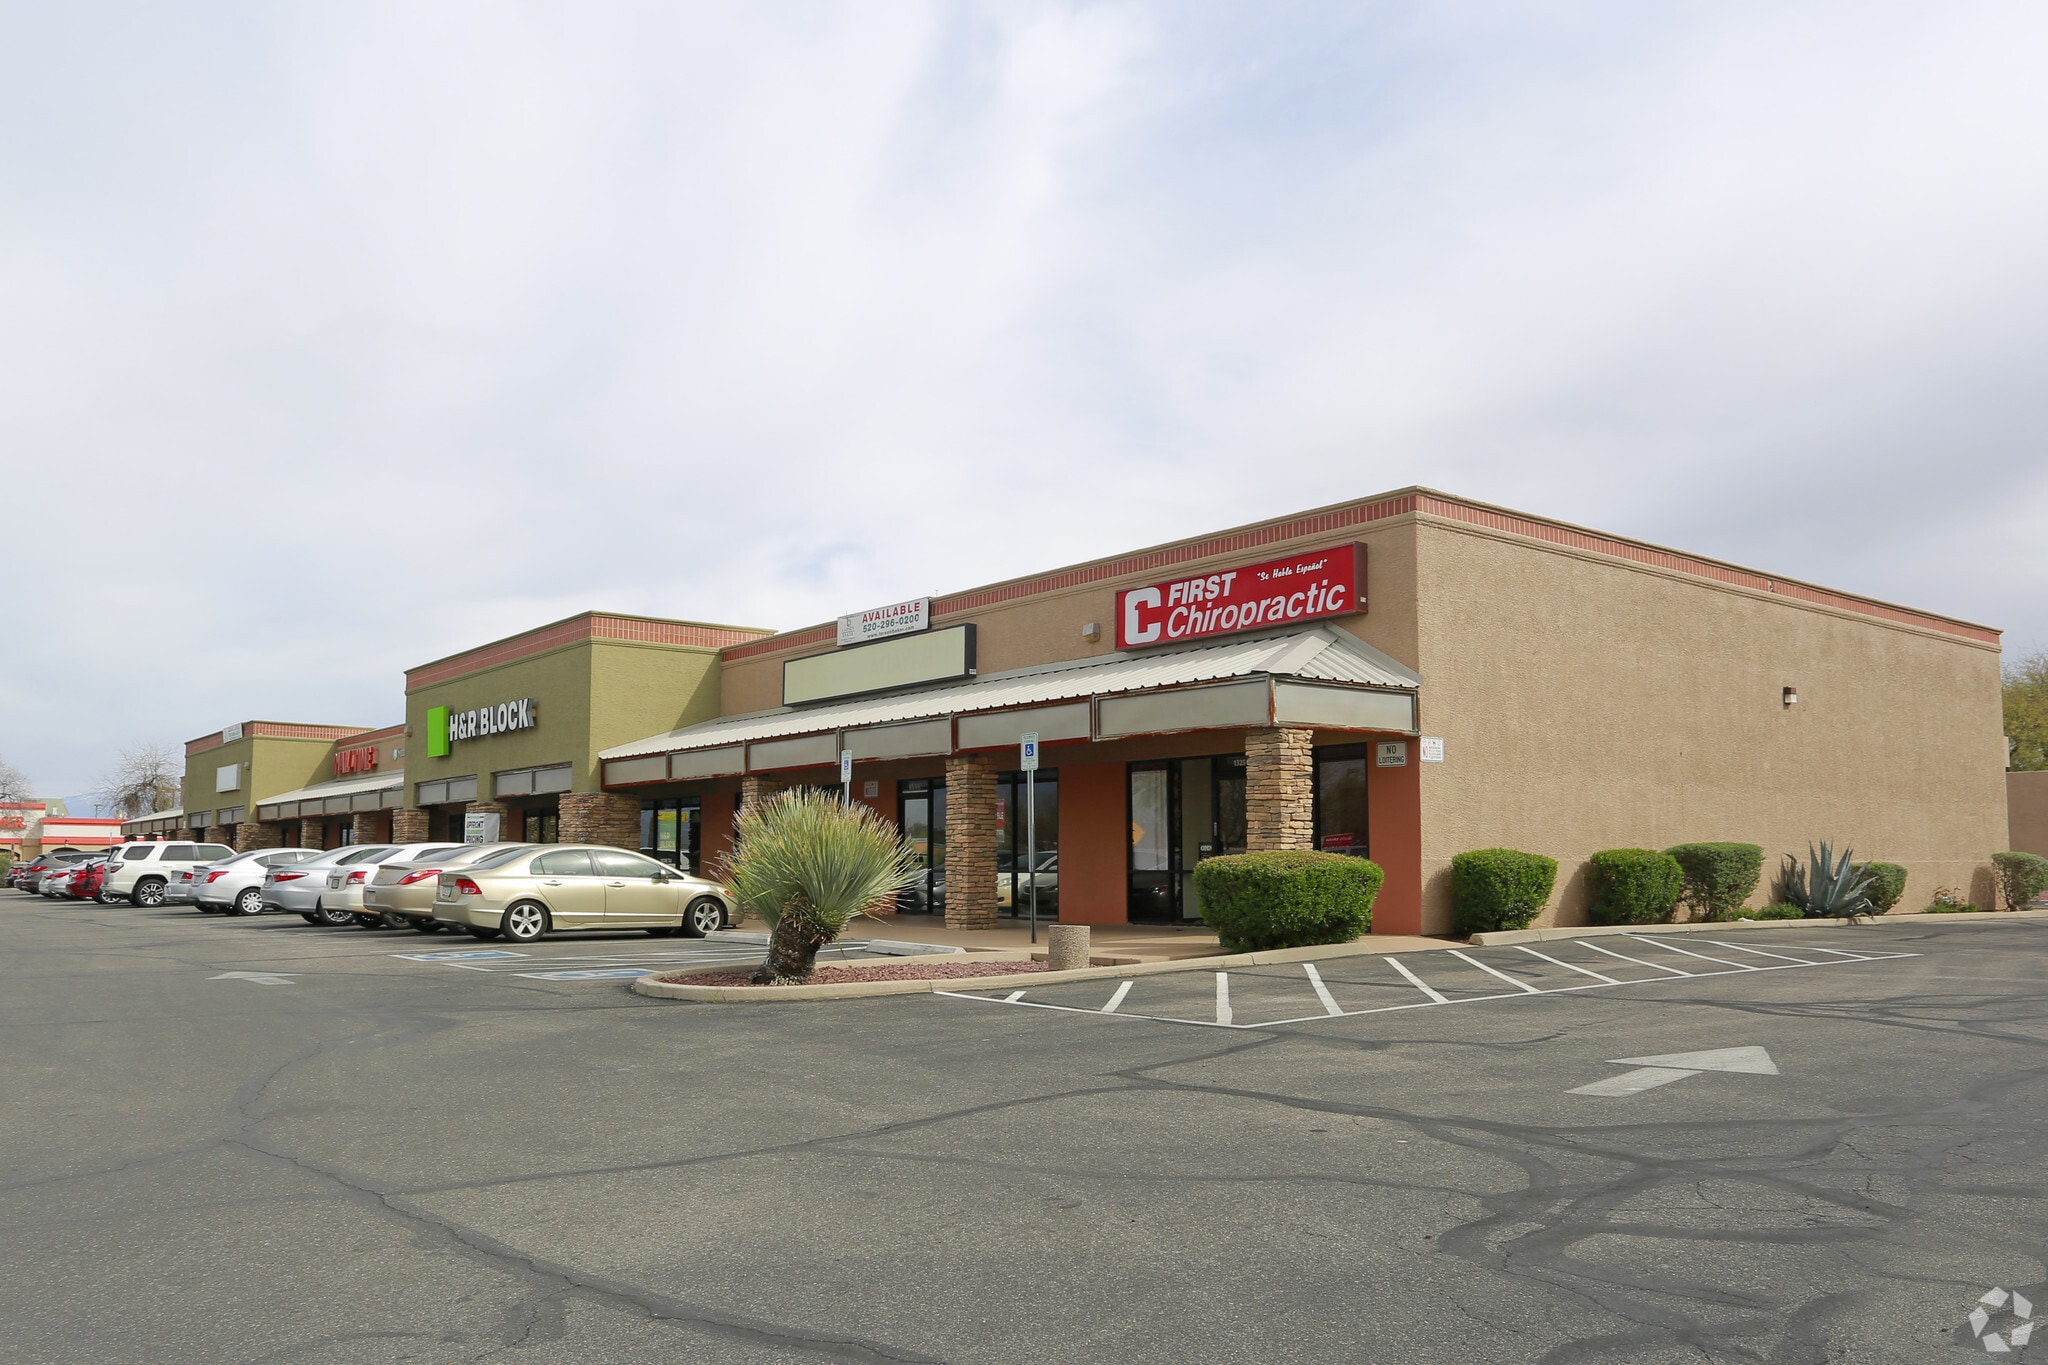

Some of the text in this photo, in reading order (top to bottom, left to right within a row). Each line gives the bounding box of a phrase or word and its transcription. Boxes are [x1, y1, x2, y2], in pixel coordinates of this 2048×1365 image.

[1272, 566, 1293, 579] Habla
[1167, 571, 1237, 608] FIRST
[862, 602, 920, 624] AVAILABLE
[1167, 578, 1346, 639] Chiropractic
[863, 613, 920, 633] 520-296-0200
[449, 698, 530, 742] H&R BLOCK
[1378, 755, 1405, 765] LOITERING
[1386, 745, 1397, 755] NO
